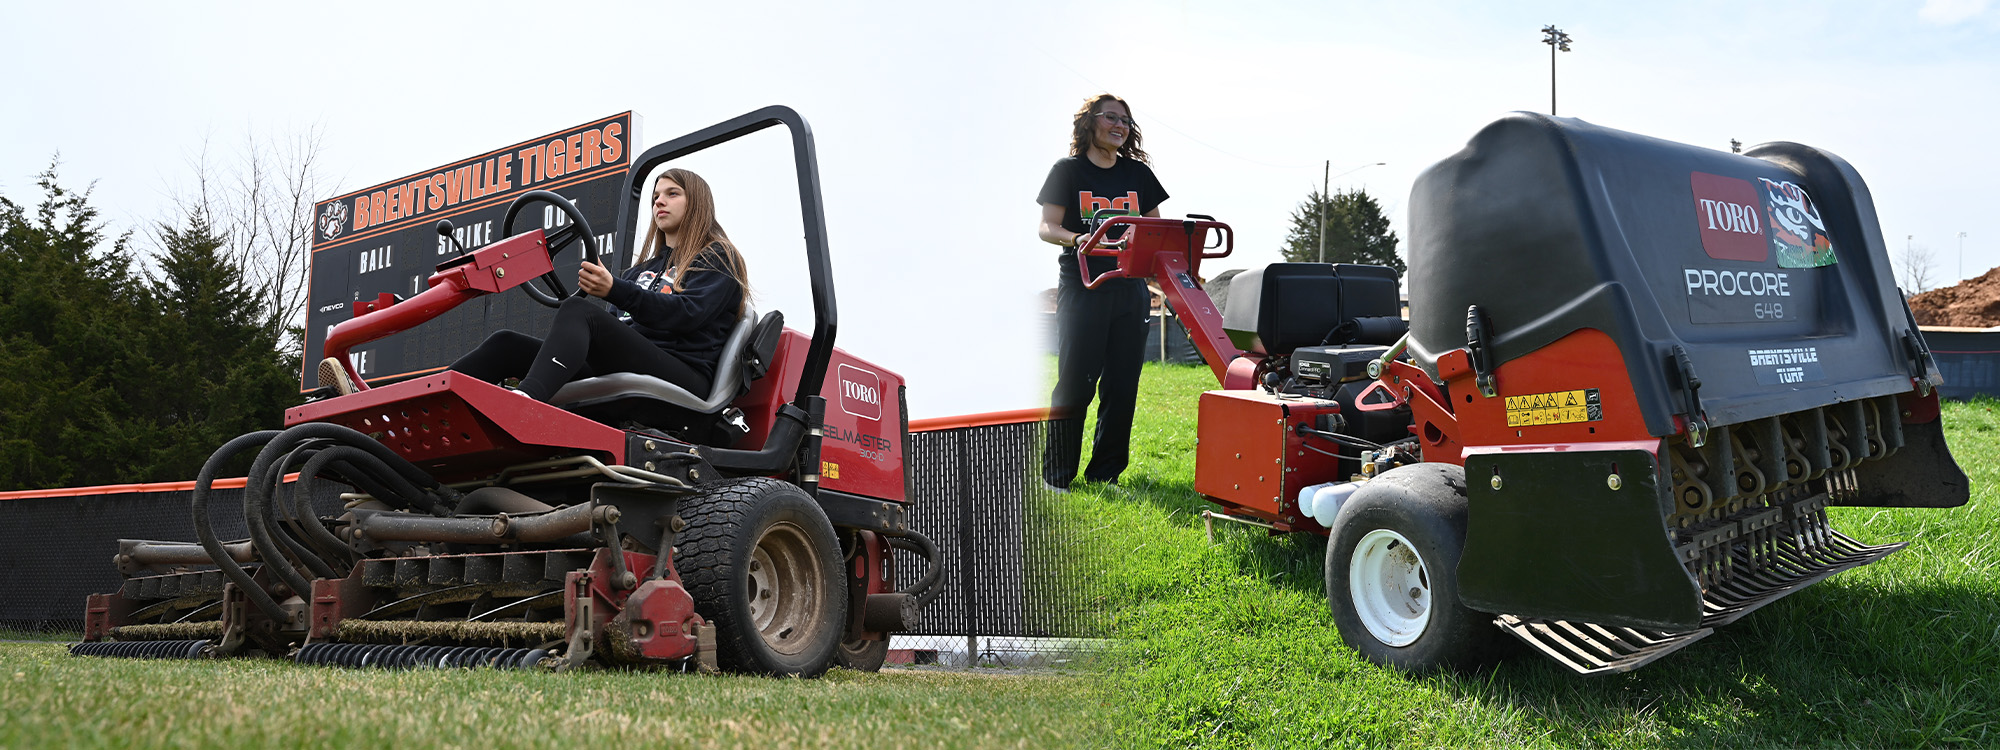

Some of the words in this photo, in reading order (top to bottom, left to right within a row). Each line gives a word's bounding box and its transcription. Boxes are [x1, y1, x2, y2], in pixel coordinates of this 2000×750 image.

[353, 153, 513, 232] BRENTSVILLE
[519, 122, 623, 187] TIGERS
[1700, 198, 1760, 236] TORO
[437, 220, 492, 256] STRIKE
[359, 245, 392, 274] BALL
[1684, 268, 1791, 297] PROCORE
[1754, 302, 1784, 320] 648
[1748, 347, 1818, 367] BRENTSVILLE
[1776, 366, 1805, 384] TURF
[842, 379, 878, 405] TORO
[822, 423, 892, 453] EELMASTER
